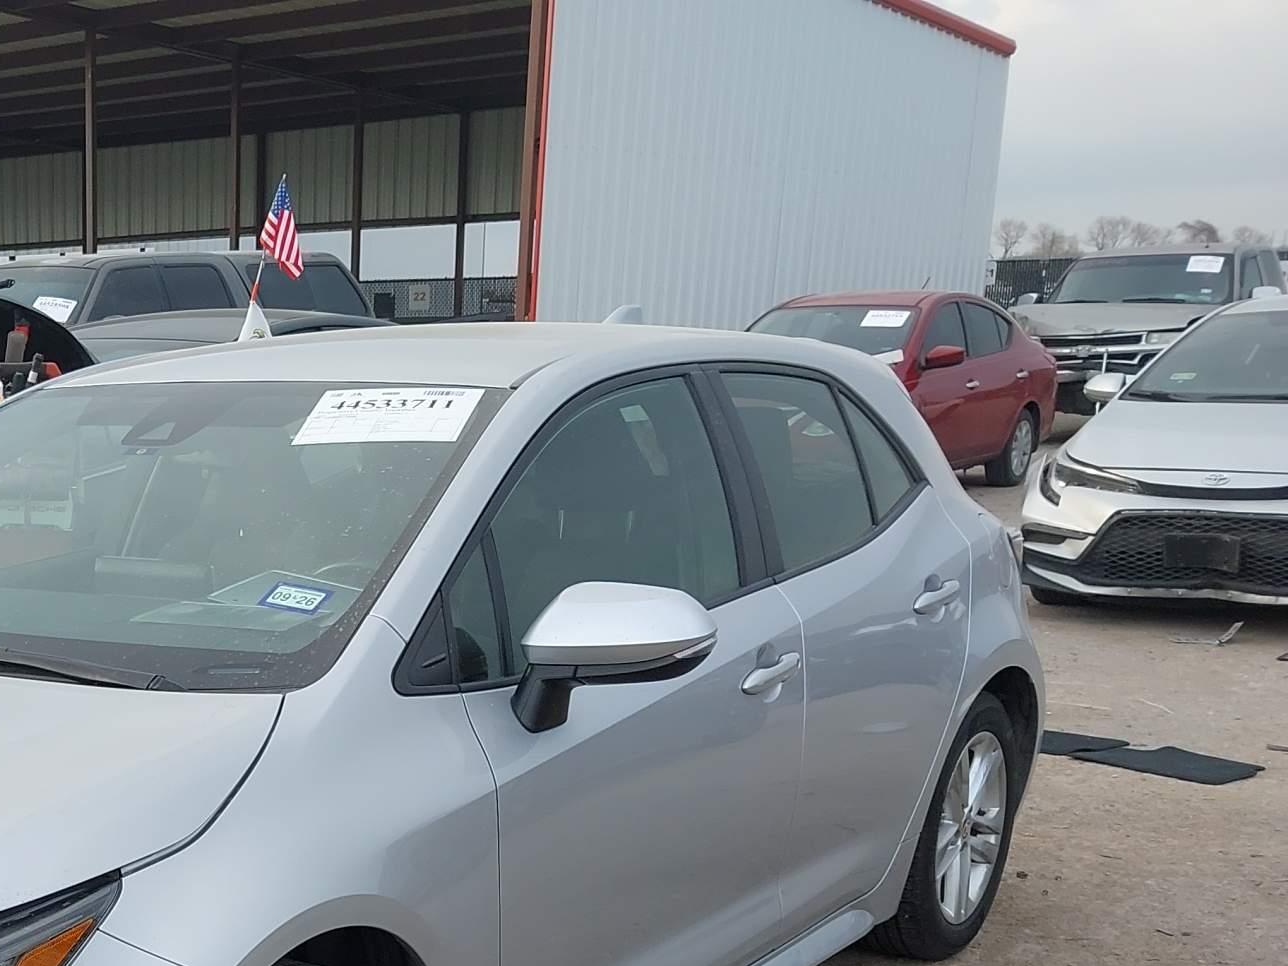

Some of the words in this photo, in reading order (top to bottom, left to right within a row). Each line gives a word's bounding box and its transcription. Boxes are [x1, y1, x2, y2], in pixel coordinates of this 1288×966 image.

[413, 291, 426, 302] 22
[330, 399, 454, 410] 44533711
[271, 591, 292, 602] 09
[295, 595, 317, 607] 26
